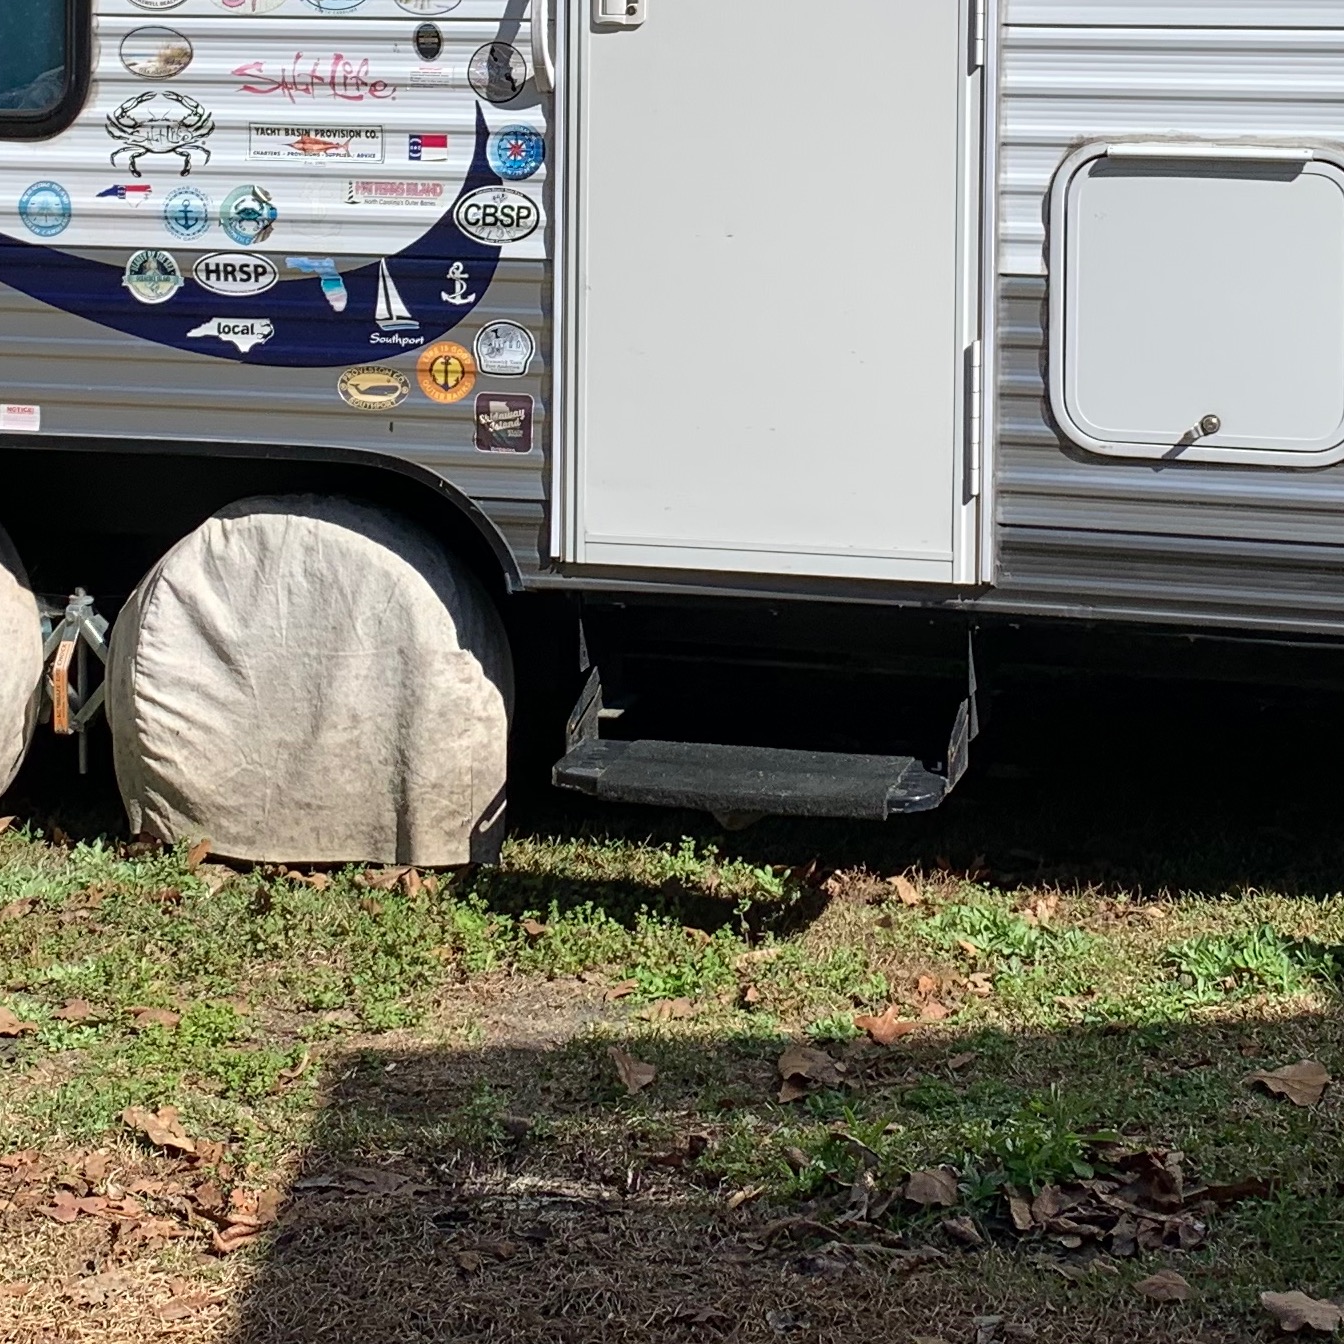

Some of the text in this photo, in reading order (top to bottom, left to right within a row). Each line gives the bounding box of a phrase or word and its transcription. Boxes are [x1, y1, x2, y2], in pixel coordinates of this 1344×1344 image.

[255, 127, 281, 136] YACHT
[285, 128, 310, 137] BASIN
[315, 129, 362, 138] PROVISION
[464, 203, 531, 228] CBSP
[204, 262, 267, 284] HRSP
[217, 322, 256, 336] local
[369, 332, 424, 347] Southport
[423, 346, 440, 363] LIFE
[452, 346, 471, 364] GOOD
[342, 366, 392, 383] PROVISION
[422, 379, 471, 400] OUTER BANKS
[348, 397, 396, 410] SOUTHPORT
[479, 409, 525, 425] Skidaway
[488, 418, 522, 432] Island
